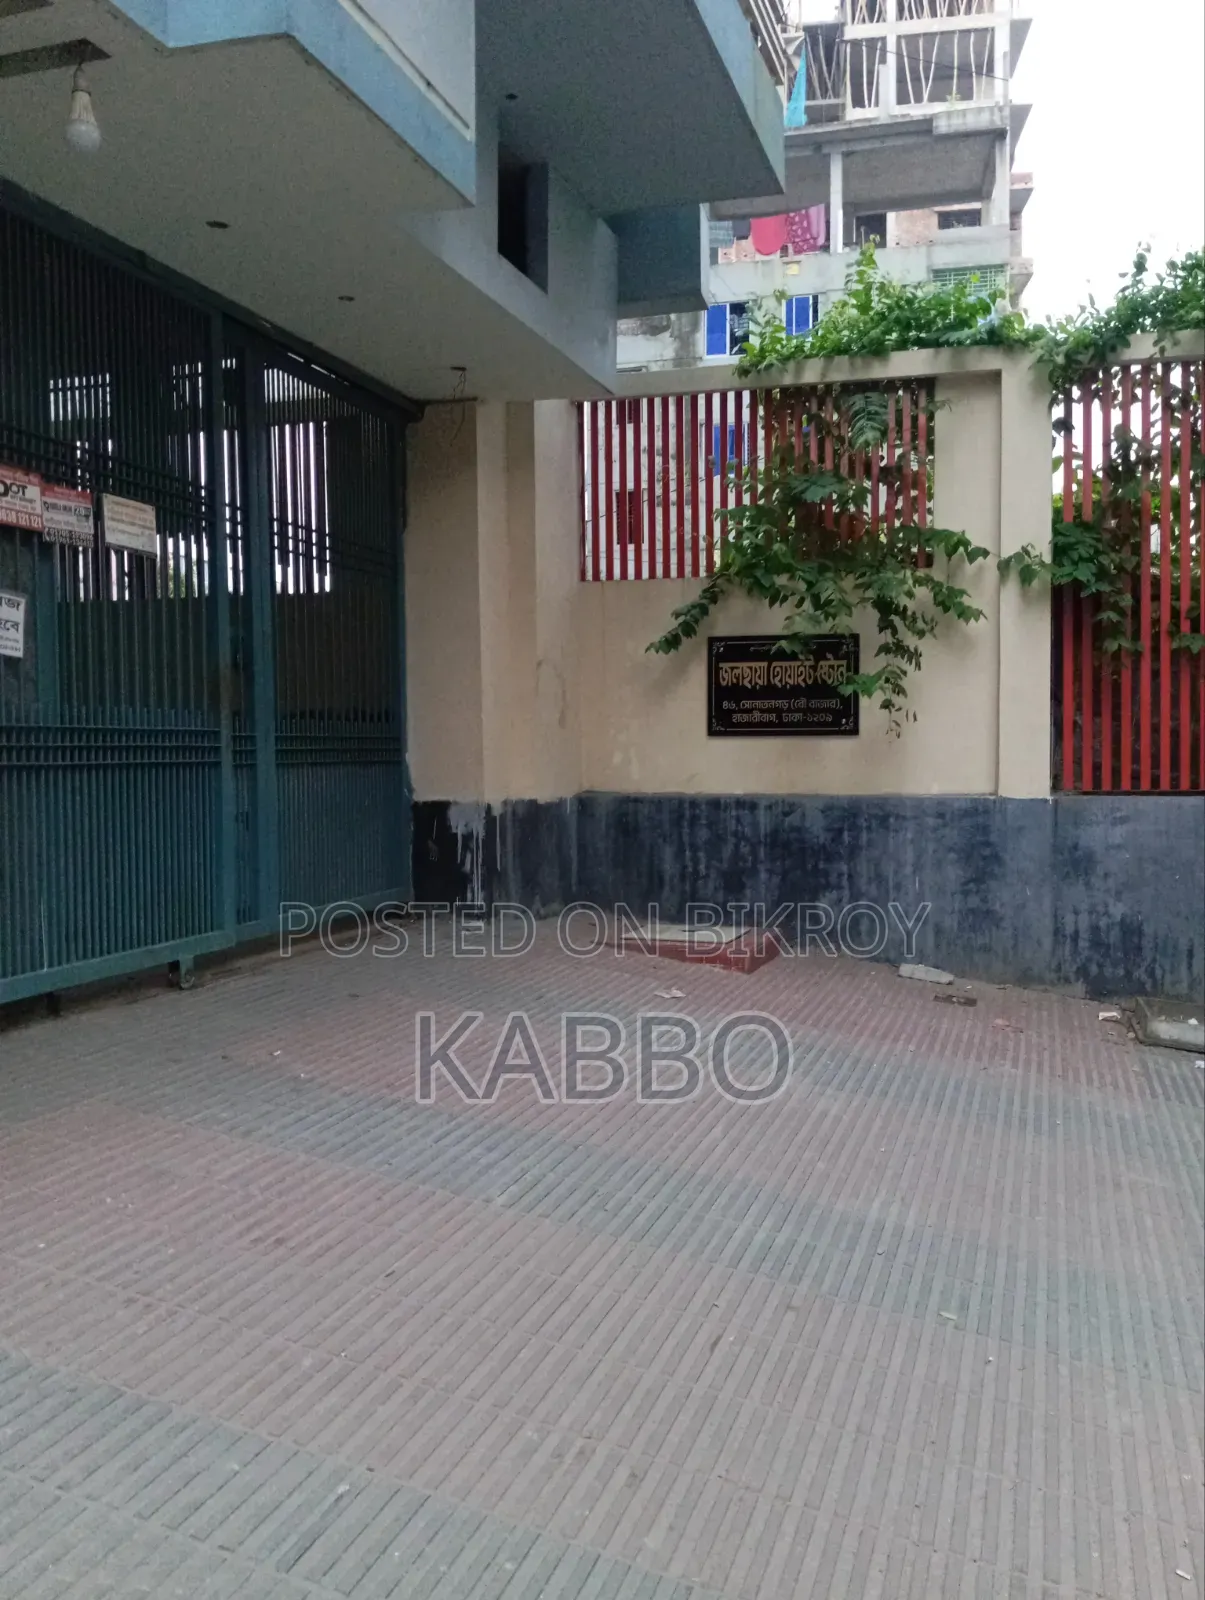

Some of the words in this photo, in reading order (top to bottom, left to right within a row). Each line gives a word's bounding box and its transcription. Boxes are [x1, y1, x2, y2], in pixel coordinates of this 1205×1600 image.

[719, 660, 768, 690] জলছায়া
[770, 653, 815, 690] হোয়াইট
[732, 710, 779, 724] হাজারীবাগ,
